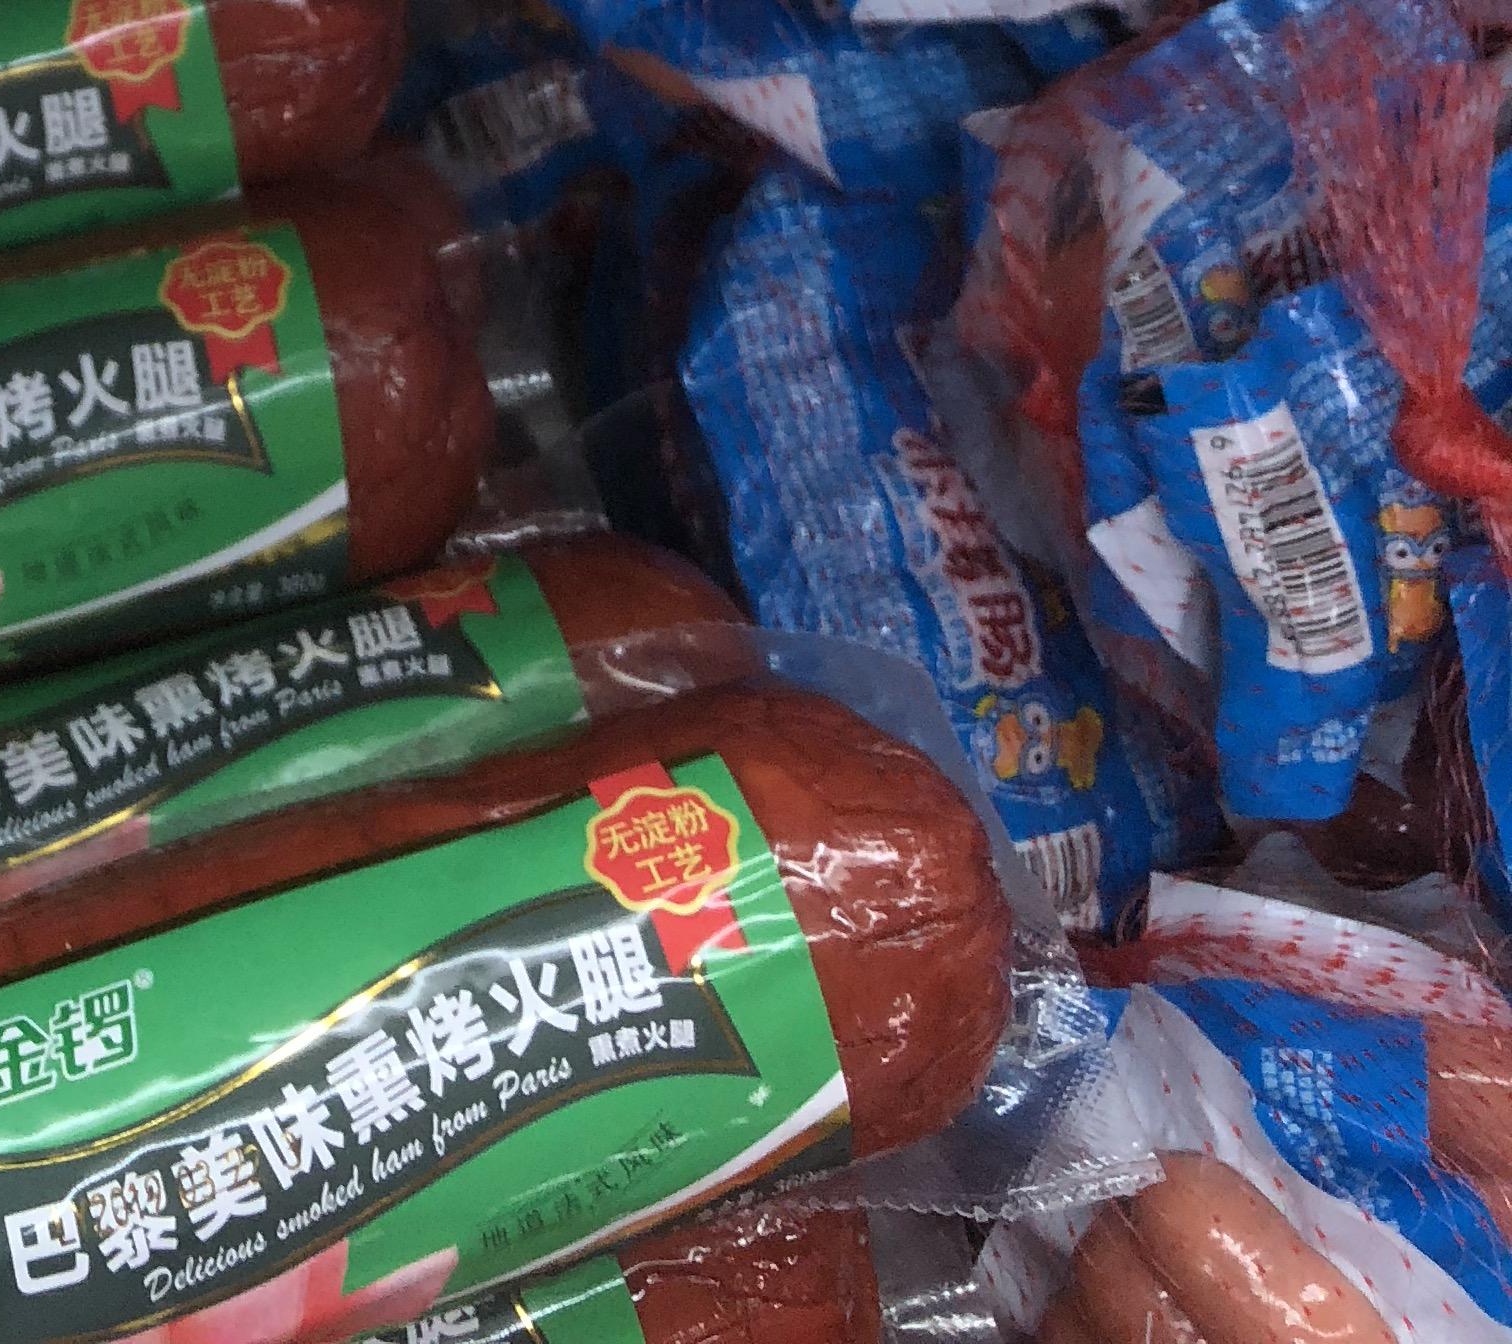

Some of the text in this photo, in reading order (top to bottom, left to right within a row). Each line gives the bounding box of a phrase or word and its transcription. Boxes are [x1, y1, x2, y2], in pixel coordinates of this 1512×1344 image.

[599, 799, 709, 860] 无淀粉
[633, 842, 714, 896] 工艺
[587, 1017, 698, 1068] 熏煮火腿
[4, 922, 664, 1296] 巴黎美味熏烤火腿
[144, 1054, 574, 1304] Delicious smoked ham from Paris
